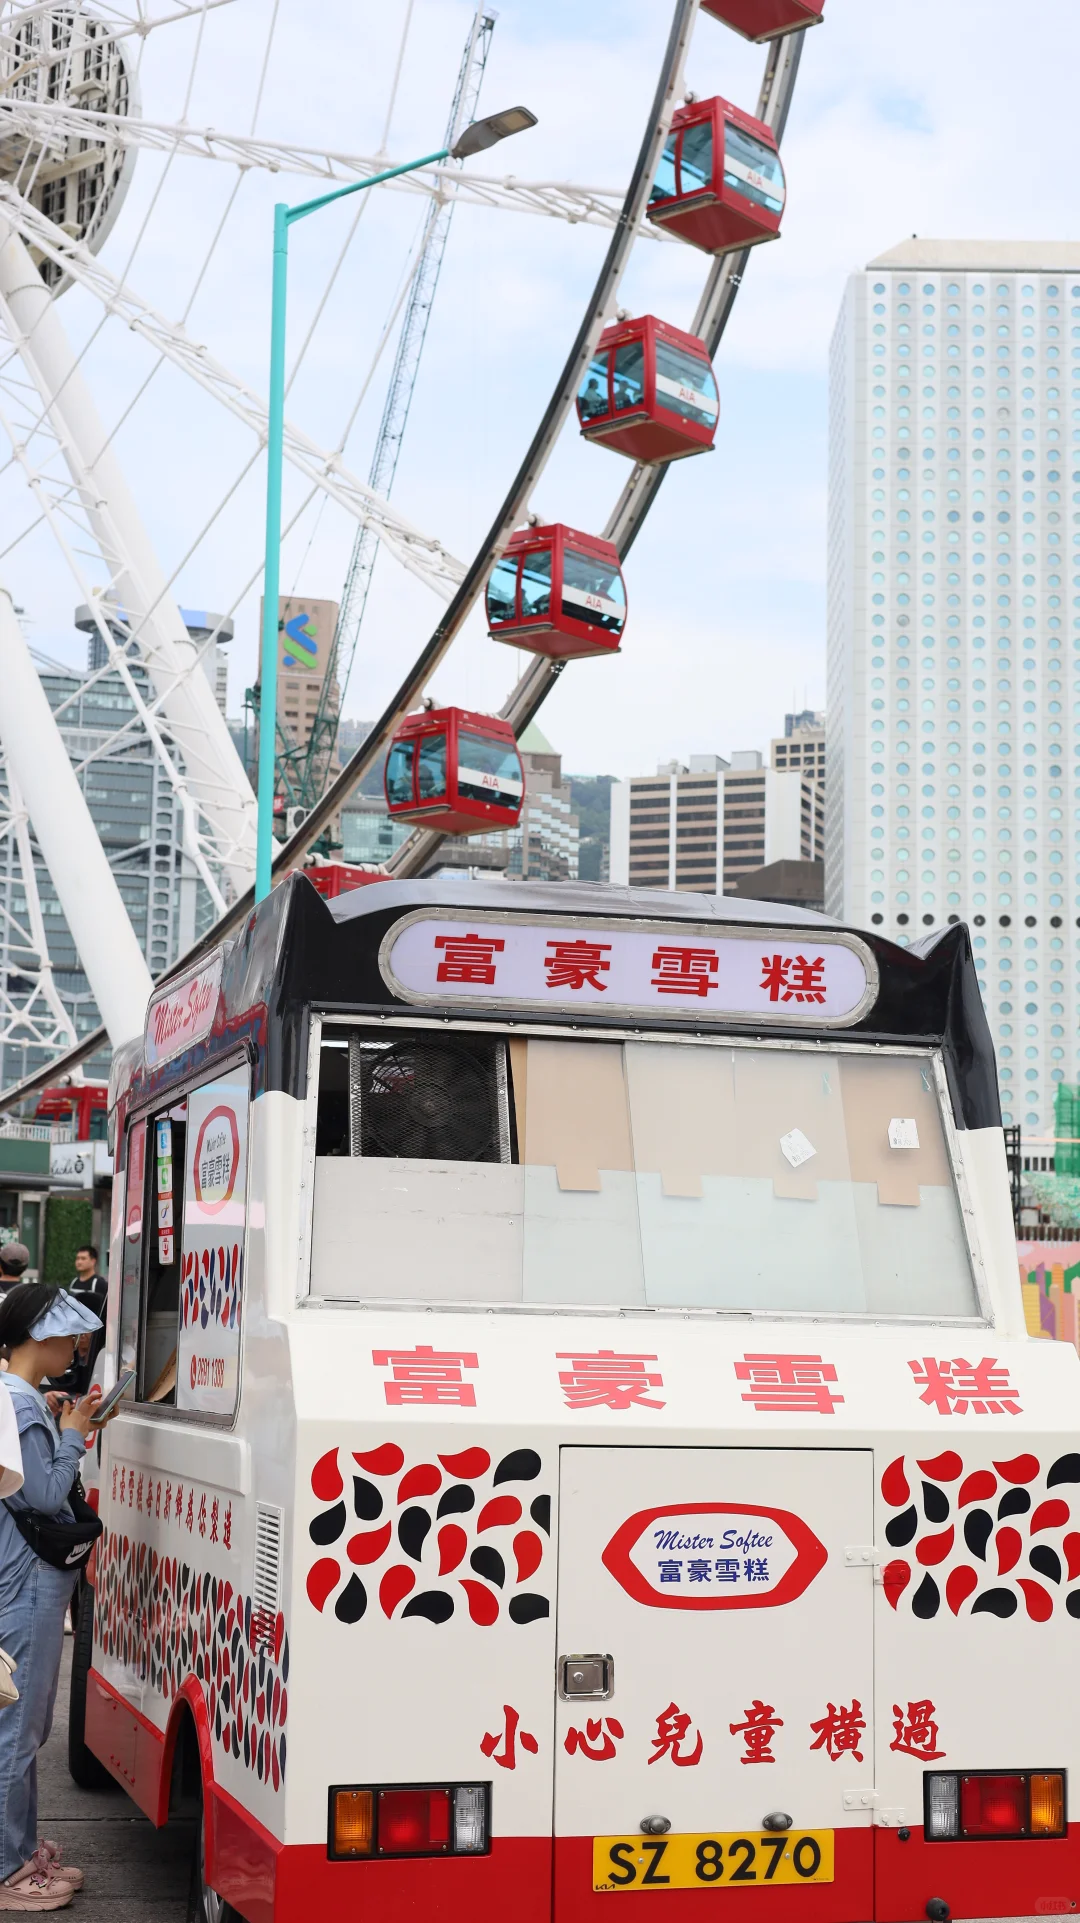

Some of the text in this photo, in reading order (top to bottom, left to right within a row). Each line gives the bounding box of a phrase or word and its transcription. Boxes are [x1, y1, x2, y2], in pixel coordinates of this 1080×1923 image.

[747, 170, 764, 188] AIA
[679, 387, 696, 404] AIA
[585, 595, 602, 611] AIA
[481, 775, 499, 790] AIA
[434, 934, 827, 1004] 富豪雪糕
[201, 1152, 231, 1189] 富豪雪糕
[372, 1345, 1024, 1415] 富豪雪糕
[653, 1529, 773, 1554] Mister Softee
[657, 1557, 770, 1583] 富豪雪糕
[609, 1836, 821, 1885] SZ 8270
